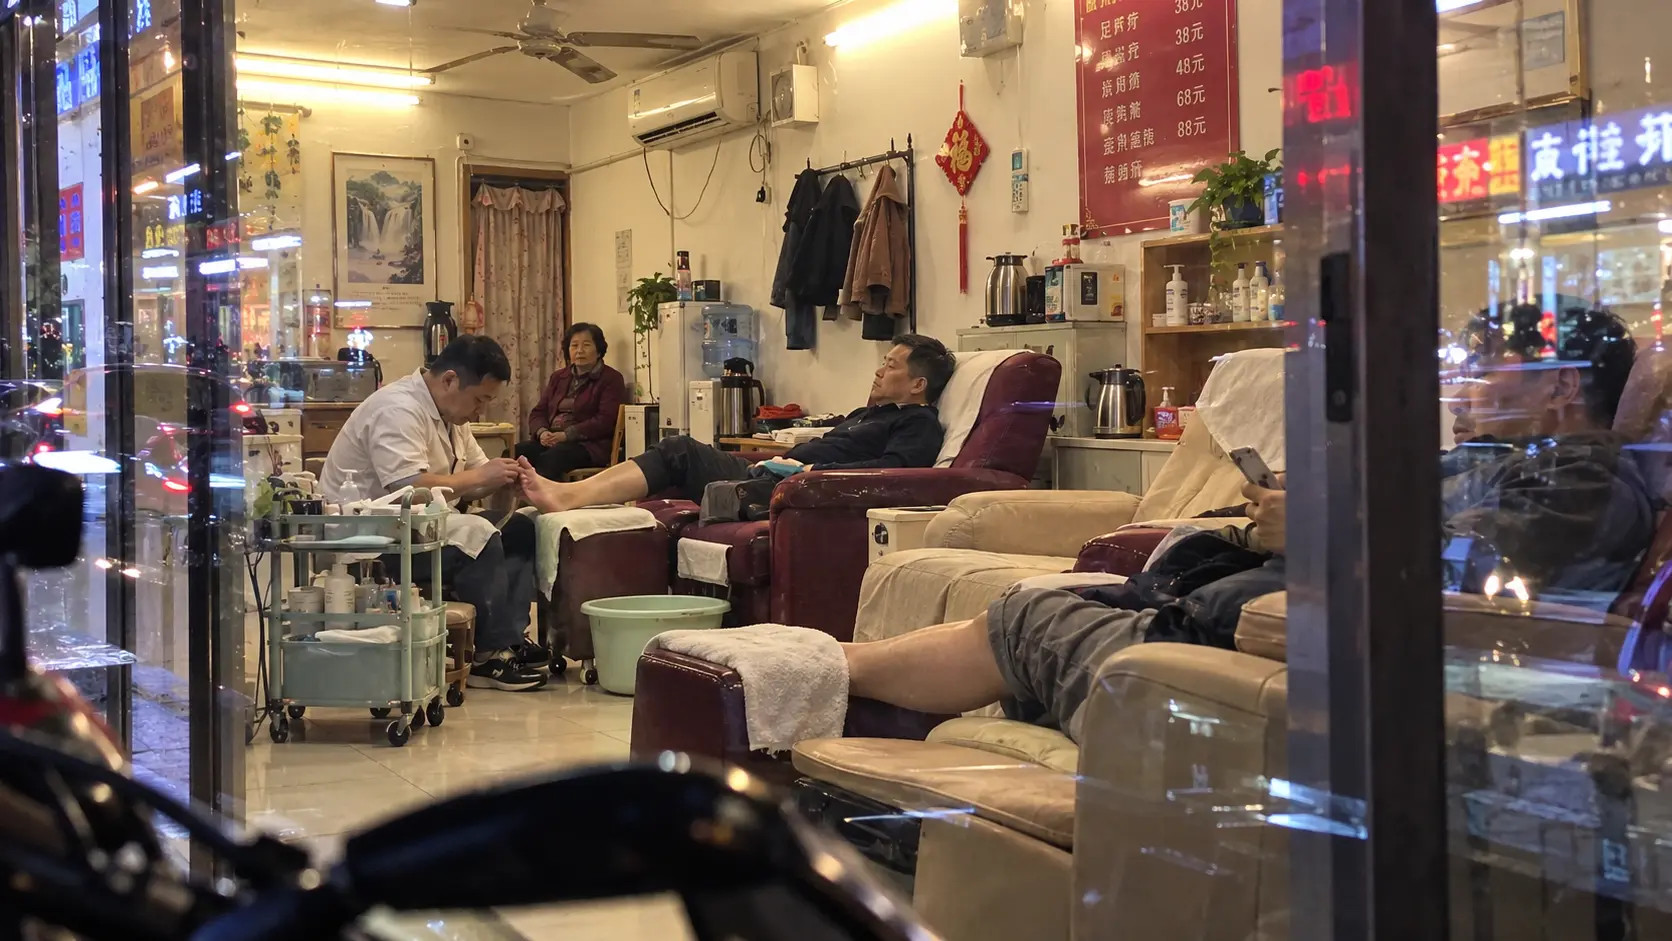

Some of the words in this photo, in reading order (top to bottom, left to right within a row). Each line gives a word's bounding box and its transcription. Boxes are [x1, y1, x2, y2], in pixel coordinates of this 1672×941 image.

[1175, 21, 1204, 45] 38元
[1176, 53, 1205, 75] 48元
[1177, 84, 1206, 107] 68元
[1178, 116, 1206, 137] 88元
